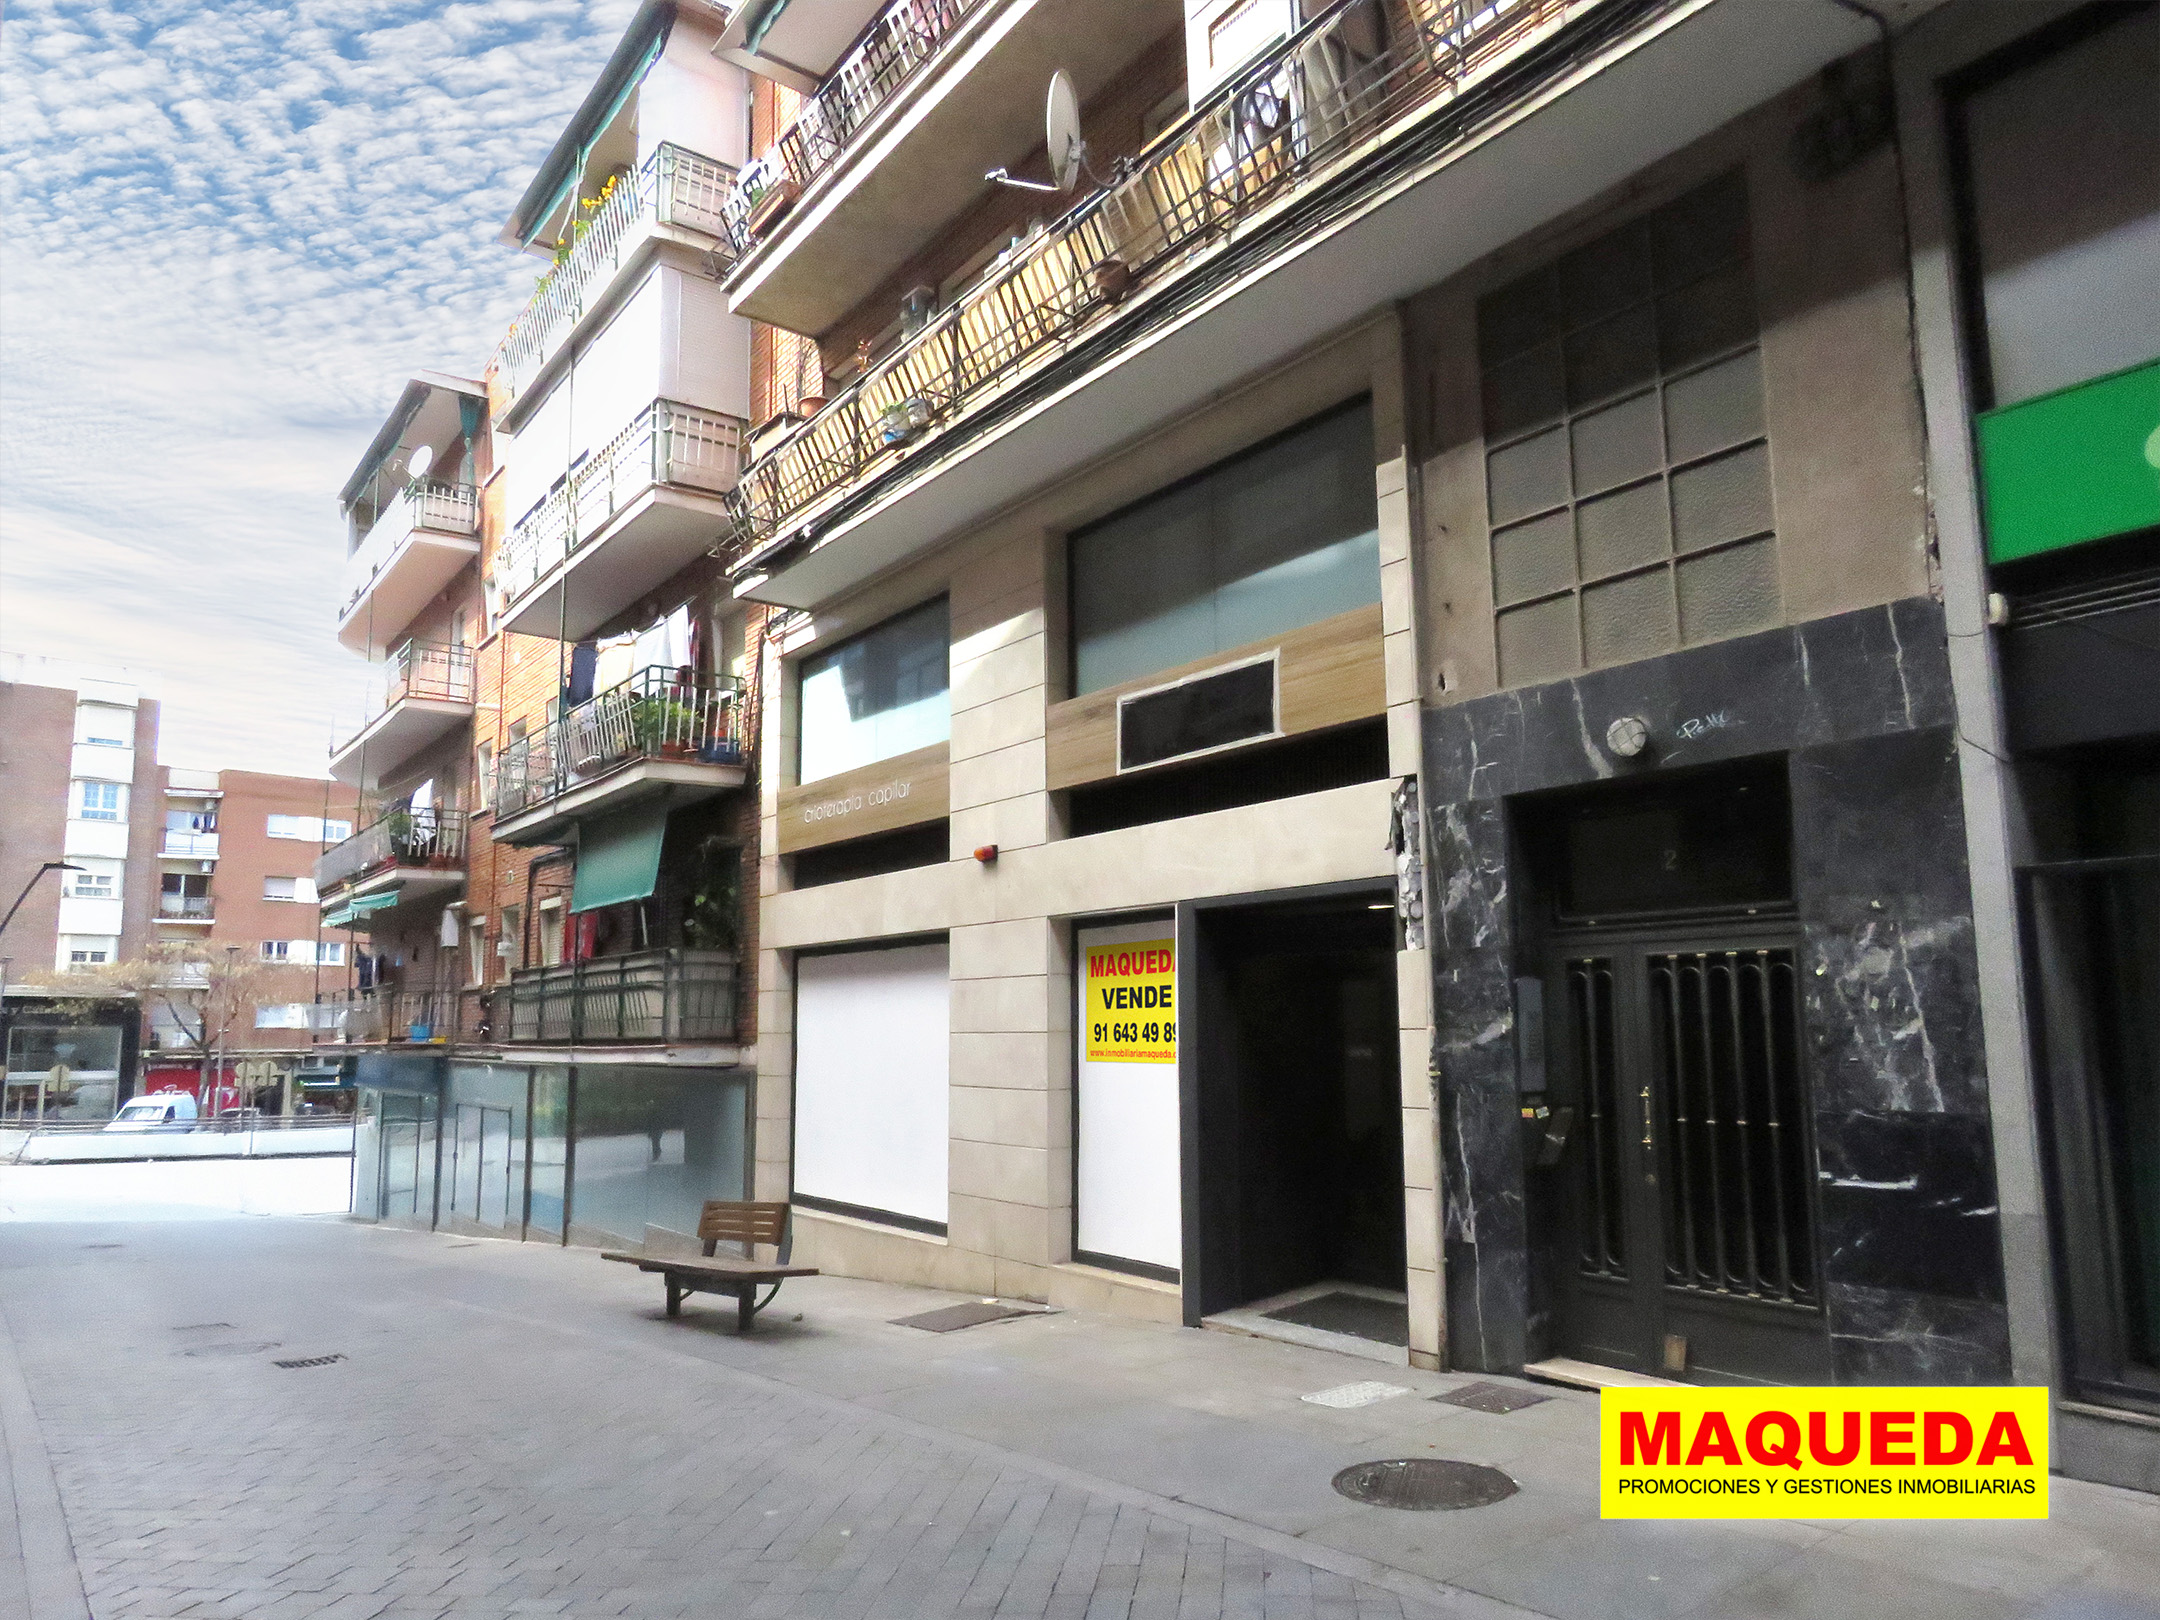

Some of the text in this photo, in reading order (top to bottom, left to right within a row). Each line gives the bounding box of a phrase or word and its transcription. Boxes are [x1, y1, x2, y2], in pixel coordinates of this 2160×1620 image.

[803, 778, 911, 823] crioterapia capilar
[1090, 949, 1176, 978] MAQUED
[1101, 985, 1172, 1010] VENDE
[1094, 1022, 1108, 1043] 91
[1113, 1022, 1138, 1043] 643
[1142, 1022, 1159, 1043] 49
